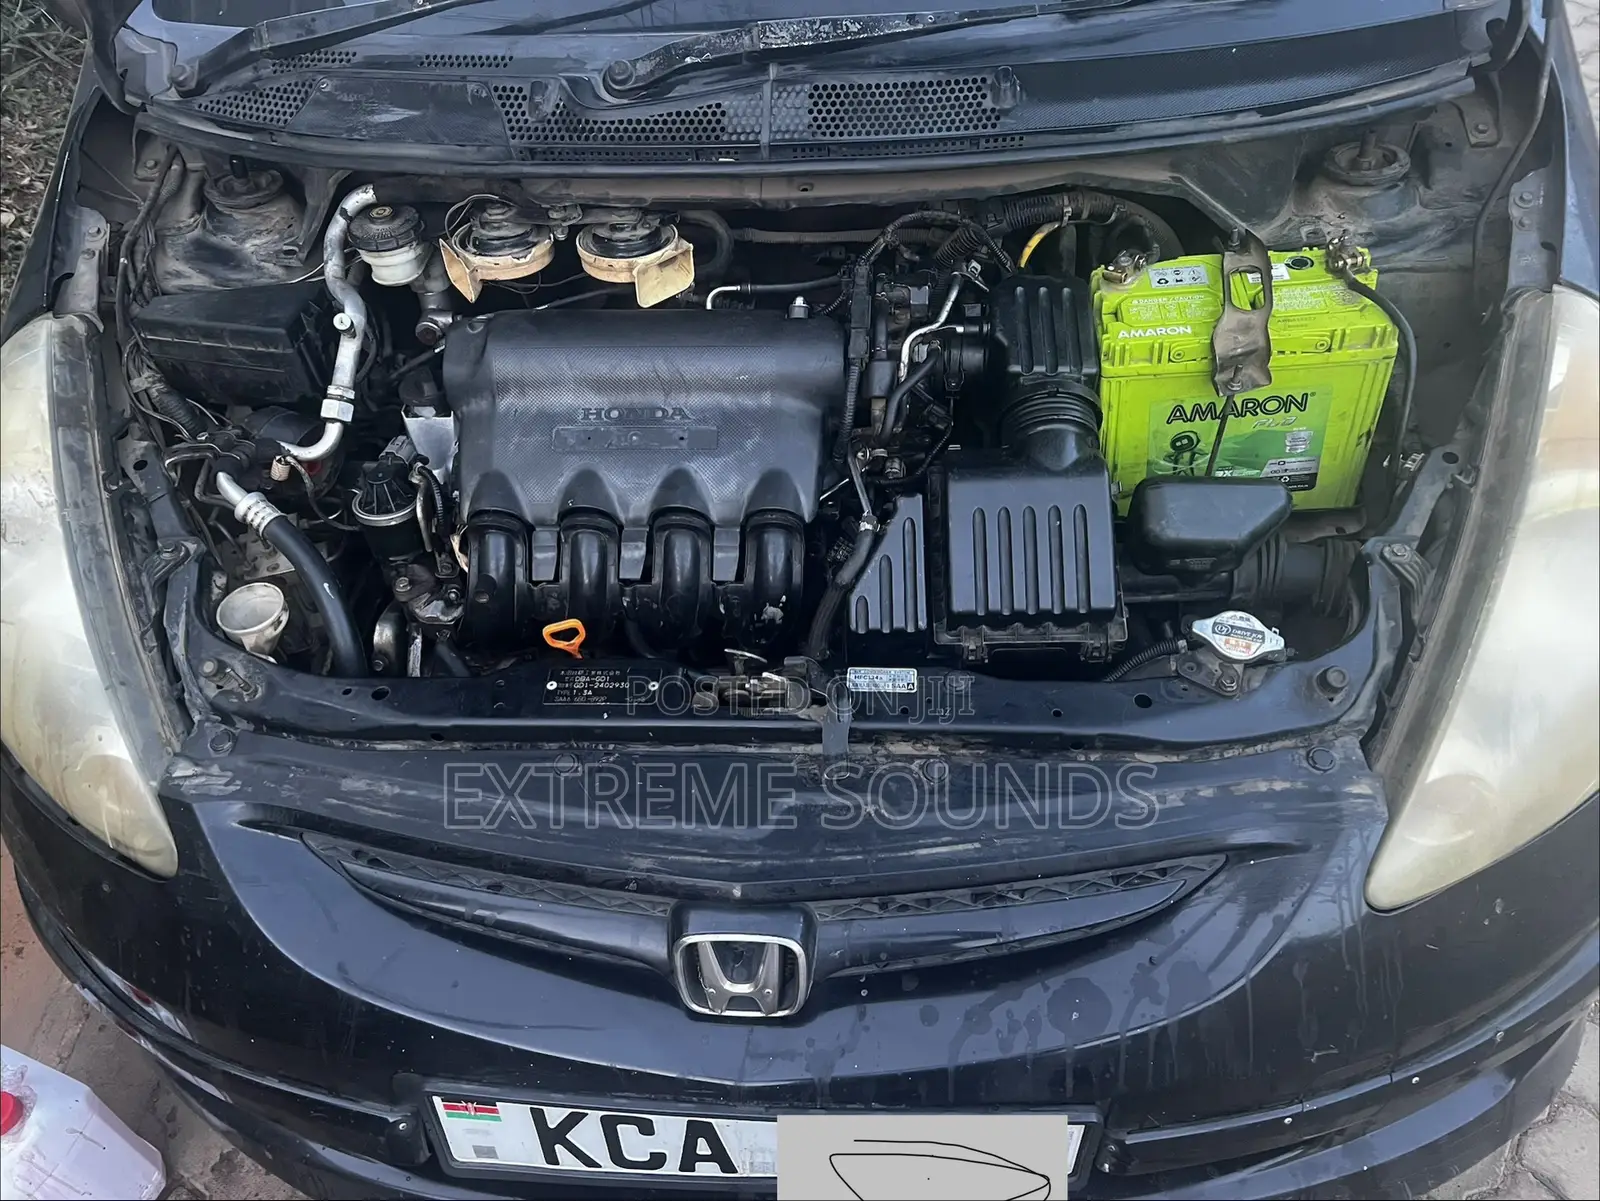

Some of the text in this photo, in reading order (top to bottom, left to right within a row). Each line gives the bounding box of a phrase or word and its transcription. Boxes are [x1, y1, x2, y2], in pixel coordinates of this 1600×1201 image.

[1118, 325, 1192, 339] AMARON
[580, 407, 692, 421] HONDA
[1166, 392, 1310, 424] AMARON
[533, 1106, 740, 1174] KCA
